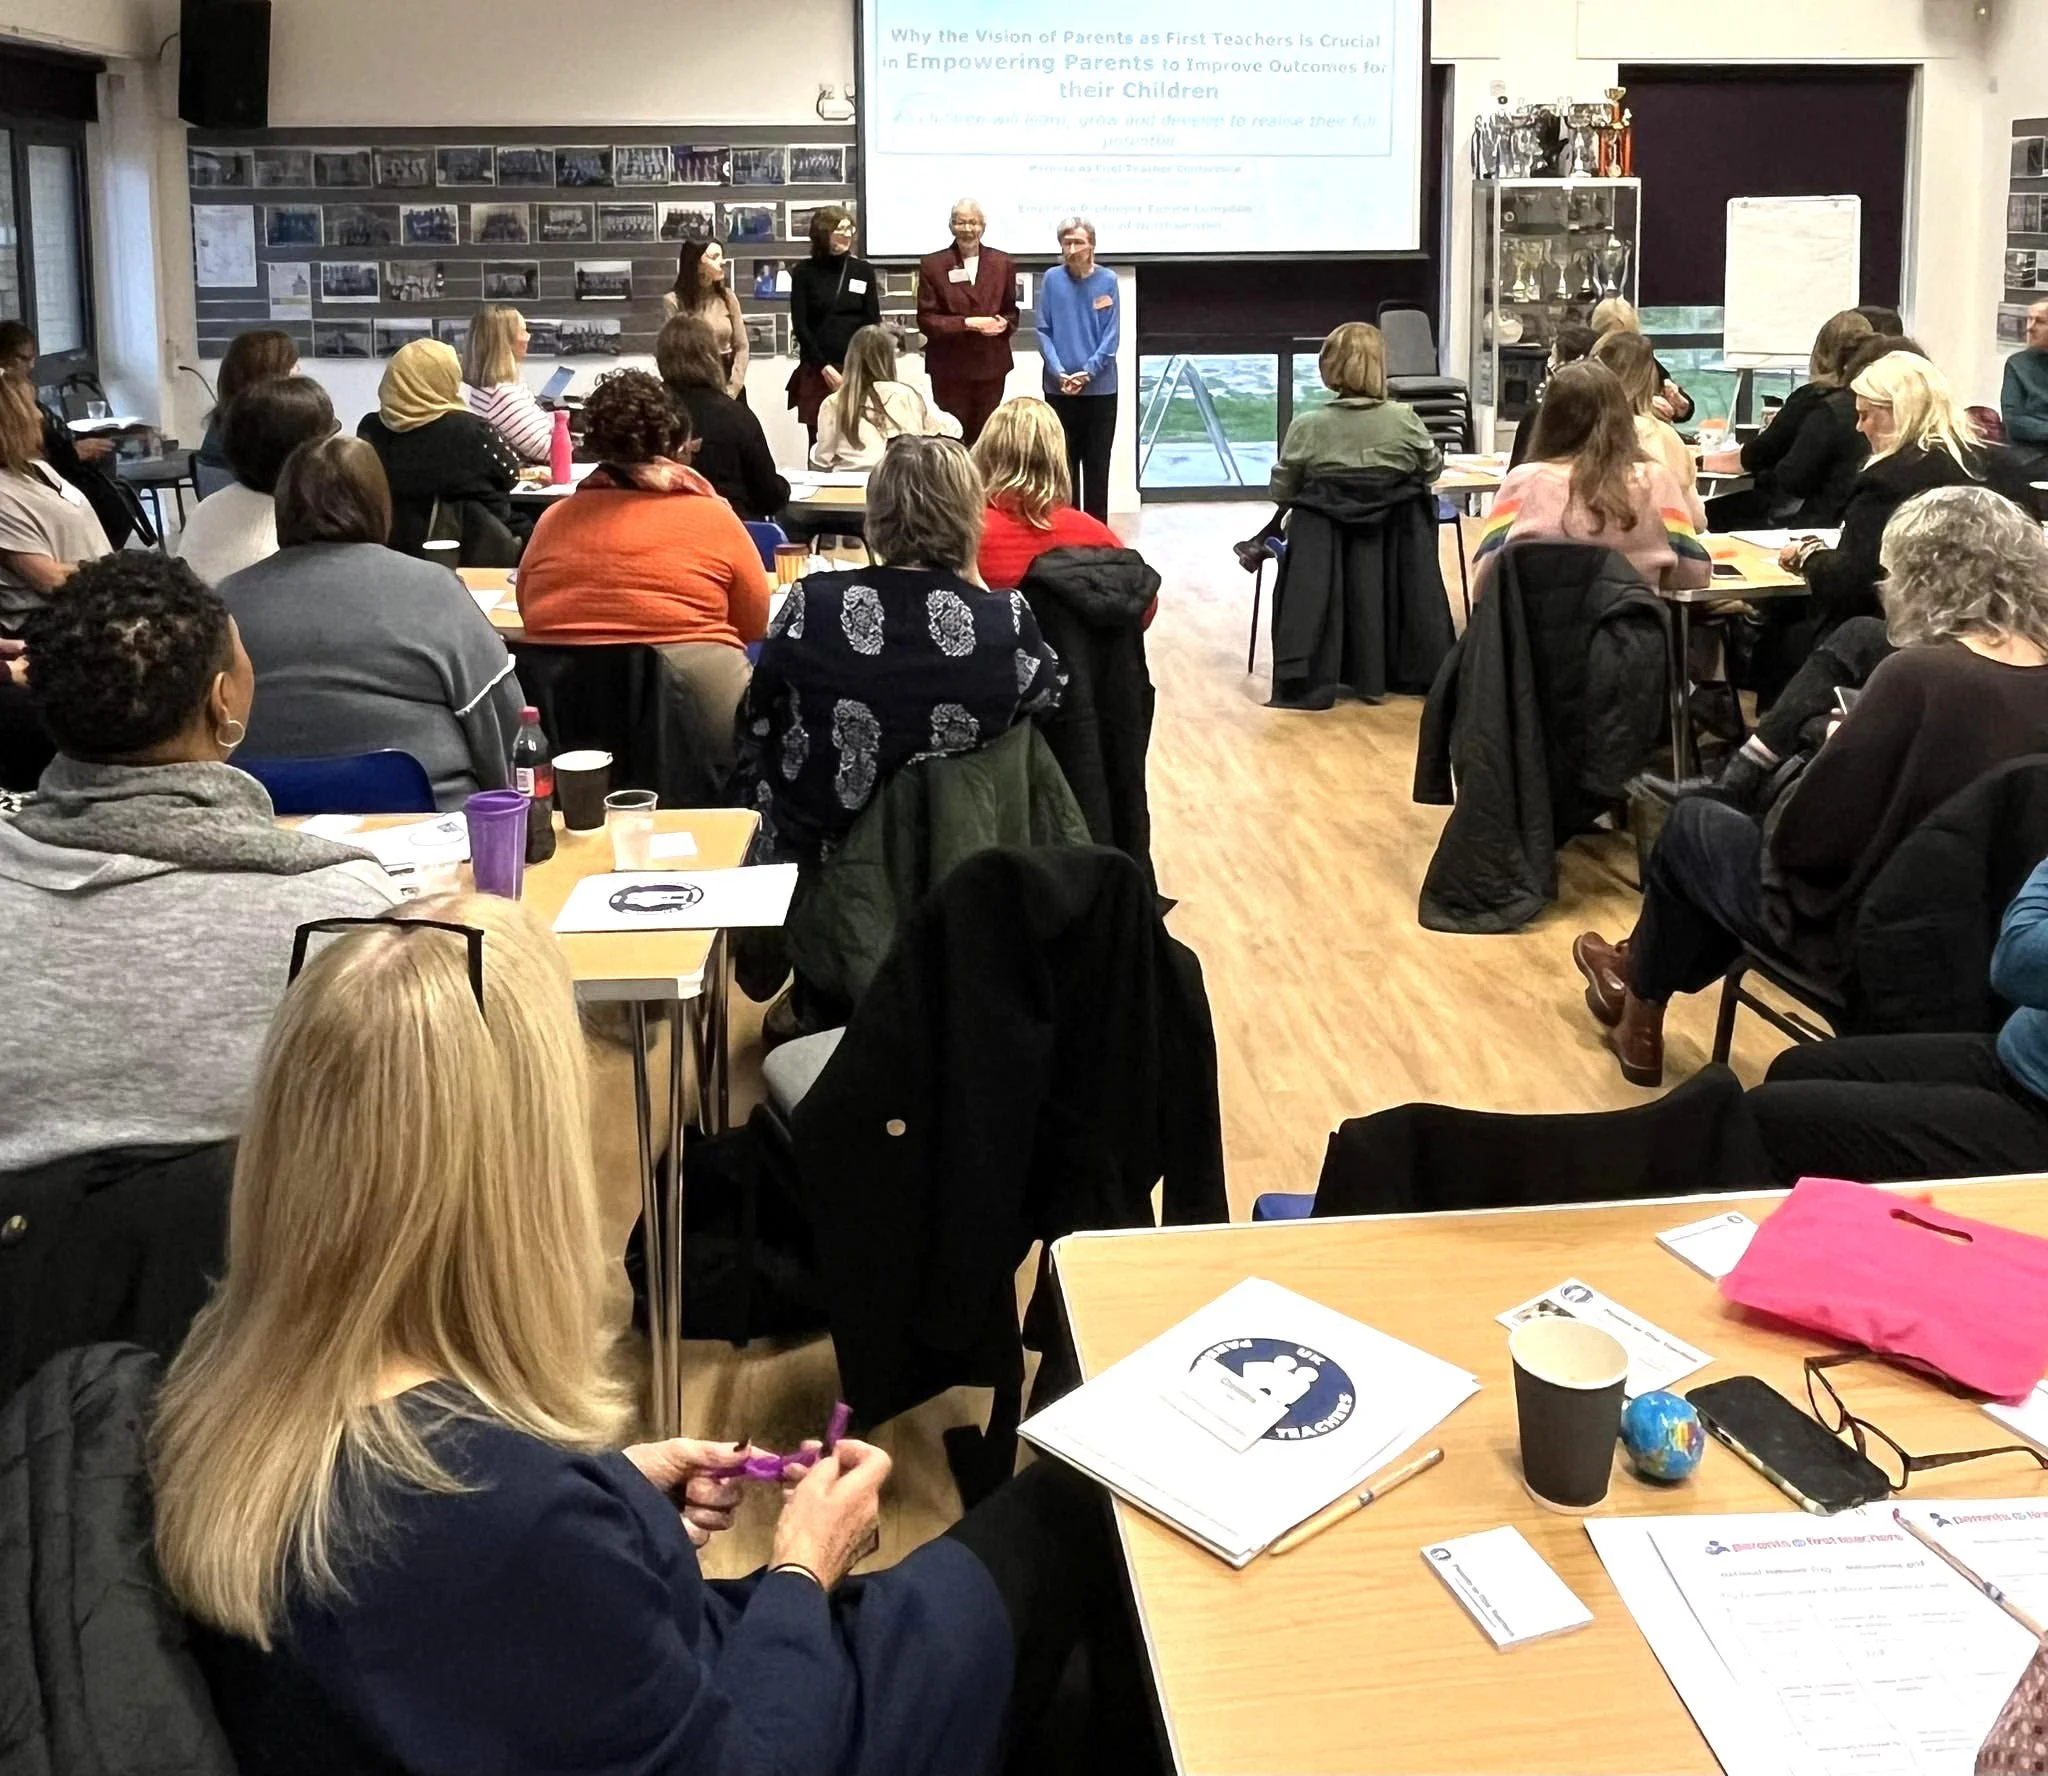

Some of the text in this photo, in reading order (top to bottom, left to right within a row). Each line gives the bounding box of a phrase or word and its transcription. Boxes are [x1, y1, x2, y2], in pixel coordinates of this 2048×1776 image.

[891, 28, 932, 47] Why
[938, 29, 969, 44] the
[975, 29, 1032, 44] Vision
[1038, 30, 1057, 44] of
[1063, 31, 1134, 45] Parents
[1139, 34, 1159, 45] as
[1166, 31, 1207, 46] First
[1212, 32, 1294, 47] Teachers
[1319, 34, 1381, 48] Crucial
[882, 53, 1387, 75] in Empowering Parents to Improve Outcomes for
[1059, 80, 1219, 100] their Children
[1079, 116, 1119, 131] grow
[1124, 113, 1156, 128] and
[1229, 114, 1248, 128] to
[1251, 114, 1304, 129] realise
[1296, 1346, 1327, 1366] UK
